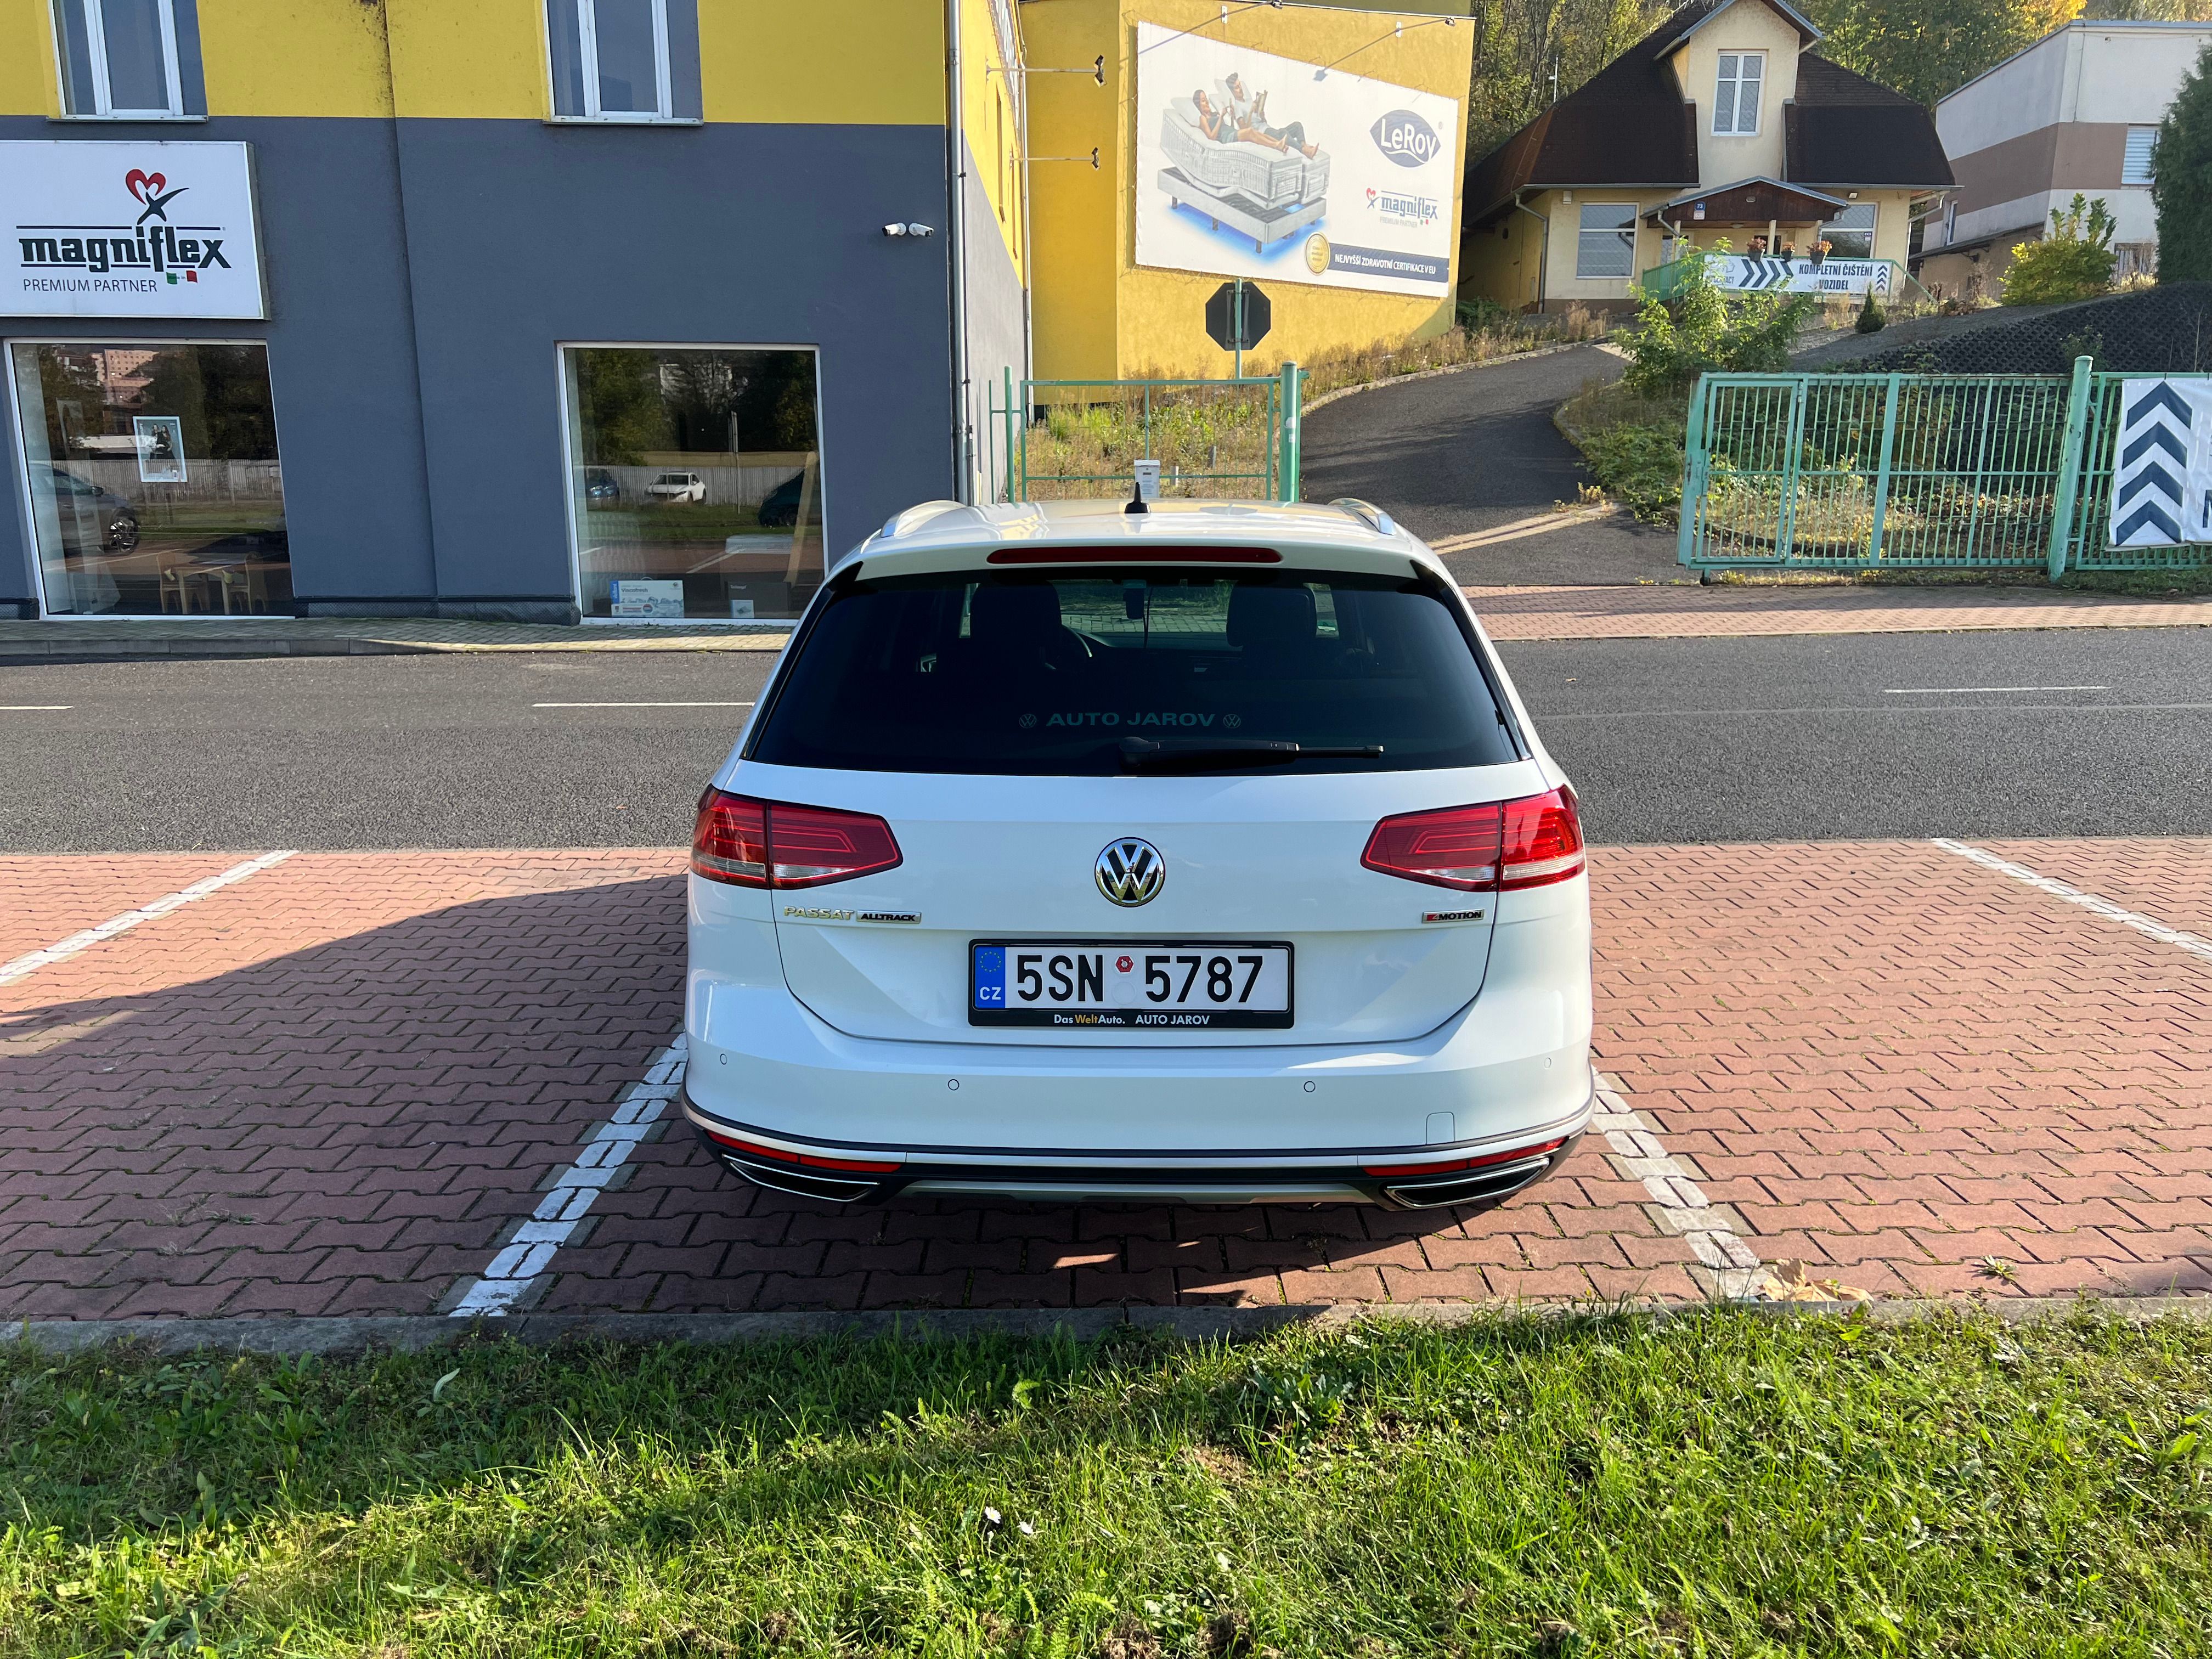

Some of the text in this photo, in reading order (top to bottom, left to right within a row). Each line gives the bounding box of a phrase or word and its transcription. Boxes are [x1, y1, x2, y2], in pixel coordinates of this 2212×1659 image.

[1381, 196, 1438, 220] magniflex
[19, 226, 232, 273] magniflex
[1335, 253, 1362, 266] NEJVYŠŠÍ
[1361, 257, 1393, 269] ZDRAVOTNÍ
[1393, 261, 1425, 273] CERTIFIKACE
[1429, 266, 1436, 274] EU
[1799, 263, 1874, 276] KOMPLETNÍ ČIŠTĚNÍ
[24, 279, 157, 292] PREMIUM PARTNER
[1819, 279, 1849, 290] VOZIDEL
[1046, 713, 1120, 726] AUTO
[1127, 713, 1216, 727] JAROV
[784, 905, 854, 921] PASSAT
[861, 913, 916, 922] ALLTRACK
[1017, 955, 1263, 1003] 5SN 5787
[979, 986, 1001, 1001] CZ
[1054, 1014, 1074, 1024] Das
[1135, 1014, 1210, 1025] AUTO JAROV
